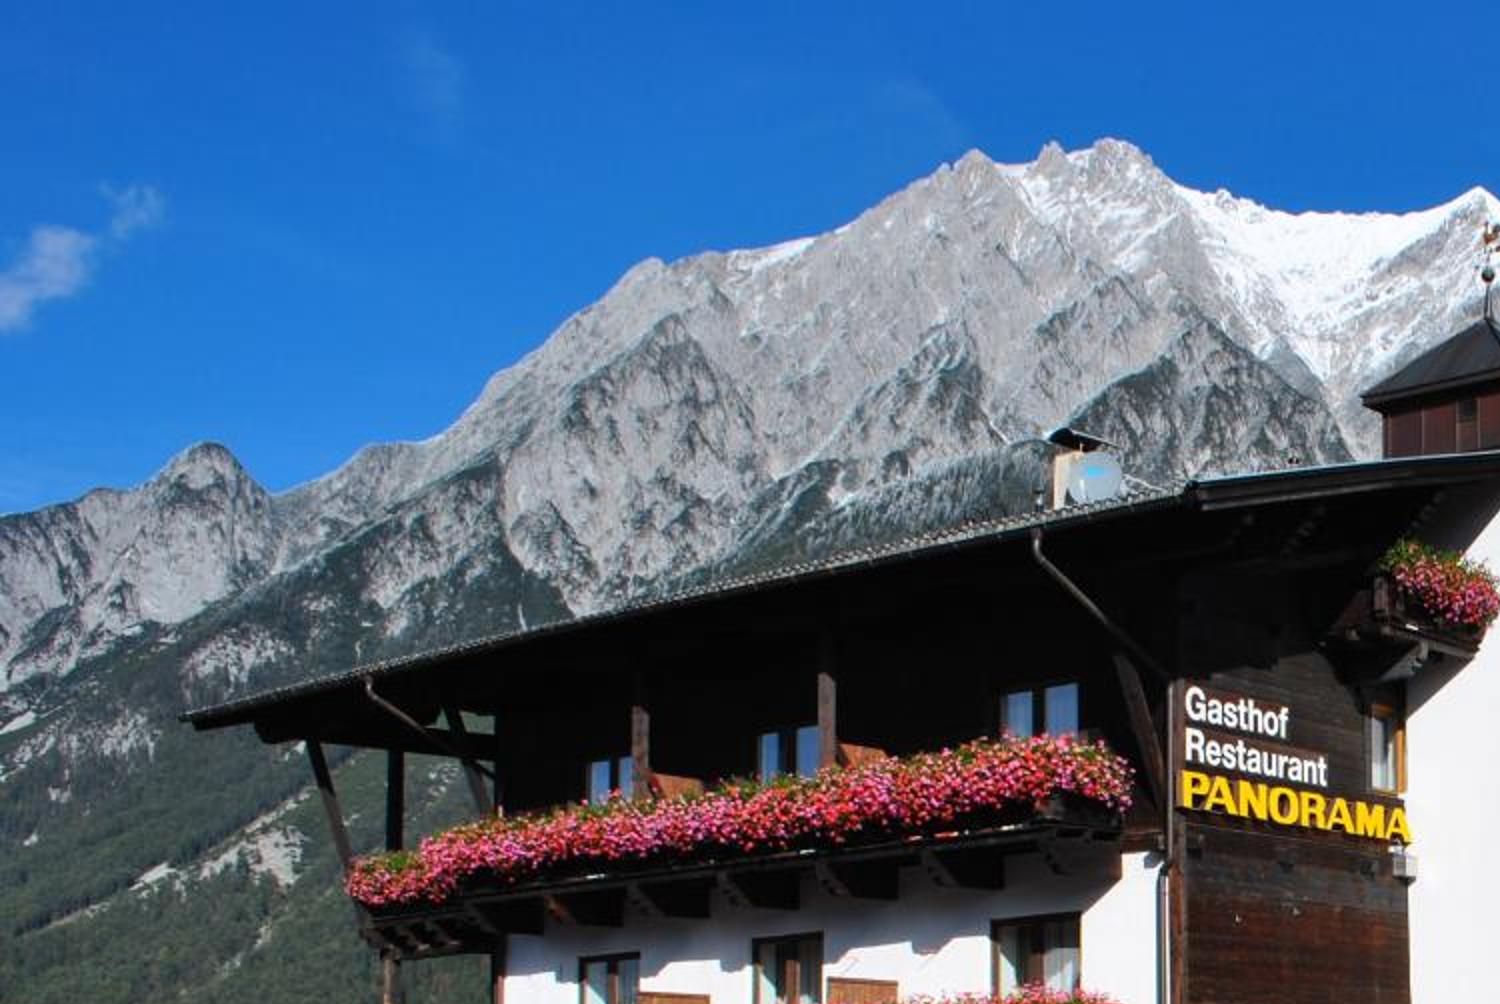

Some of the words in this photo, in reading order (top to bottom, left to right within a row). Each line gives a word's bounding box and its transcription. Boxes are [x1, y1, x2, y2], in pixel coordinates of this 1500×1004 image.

[1185, 686, 1289, 739] Gasthof
[1185, 727, 1328, 787] Restaurant
[1181, 769, 1412, 844] PANORAMA
